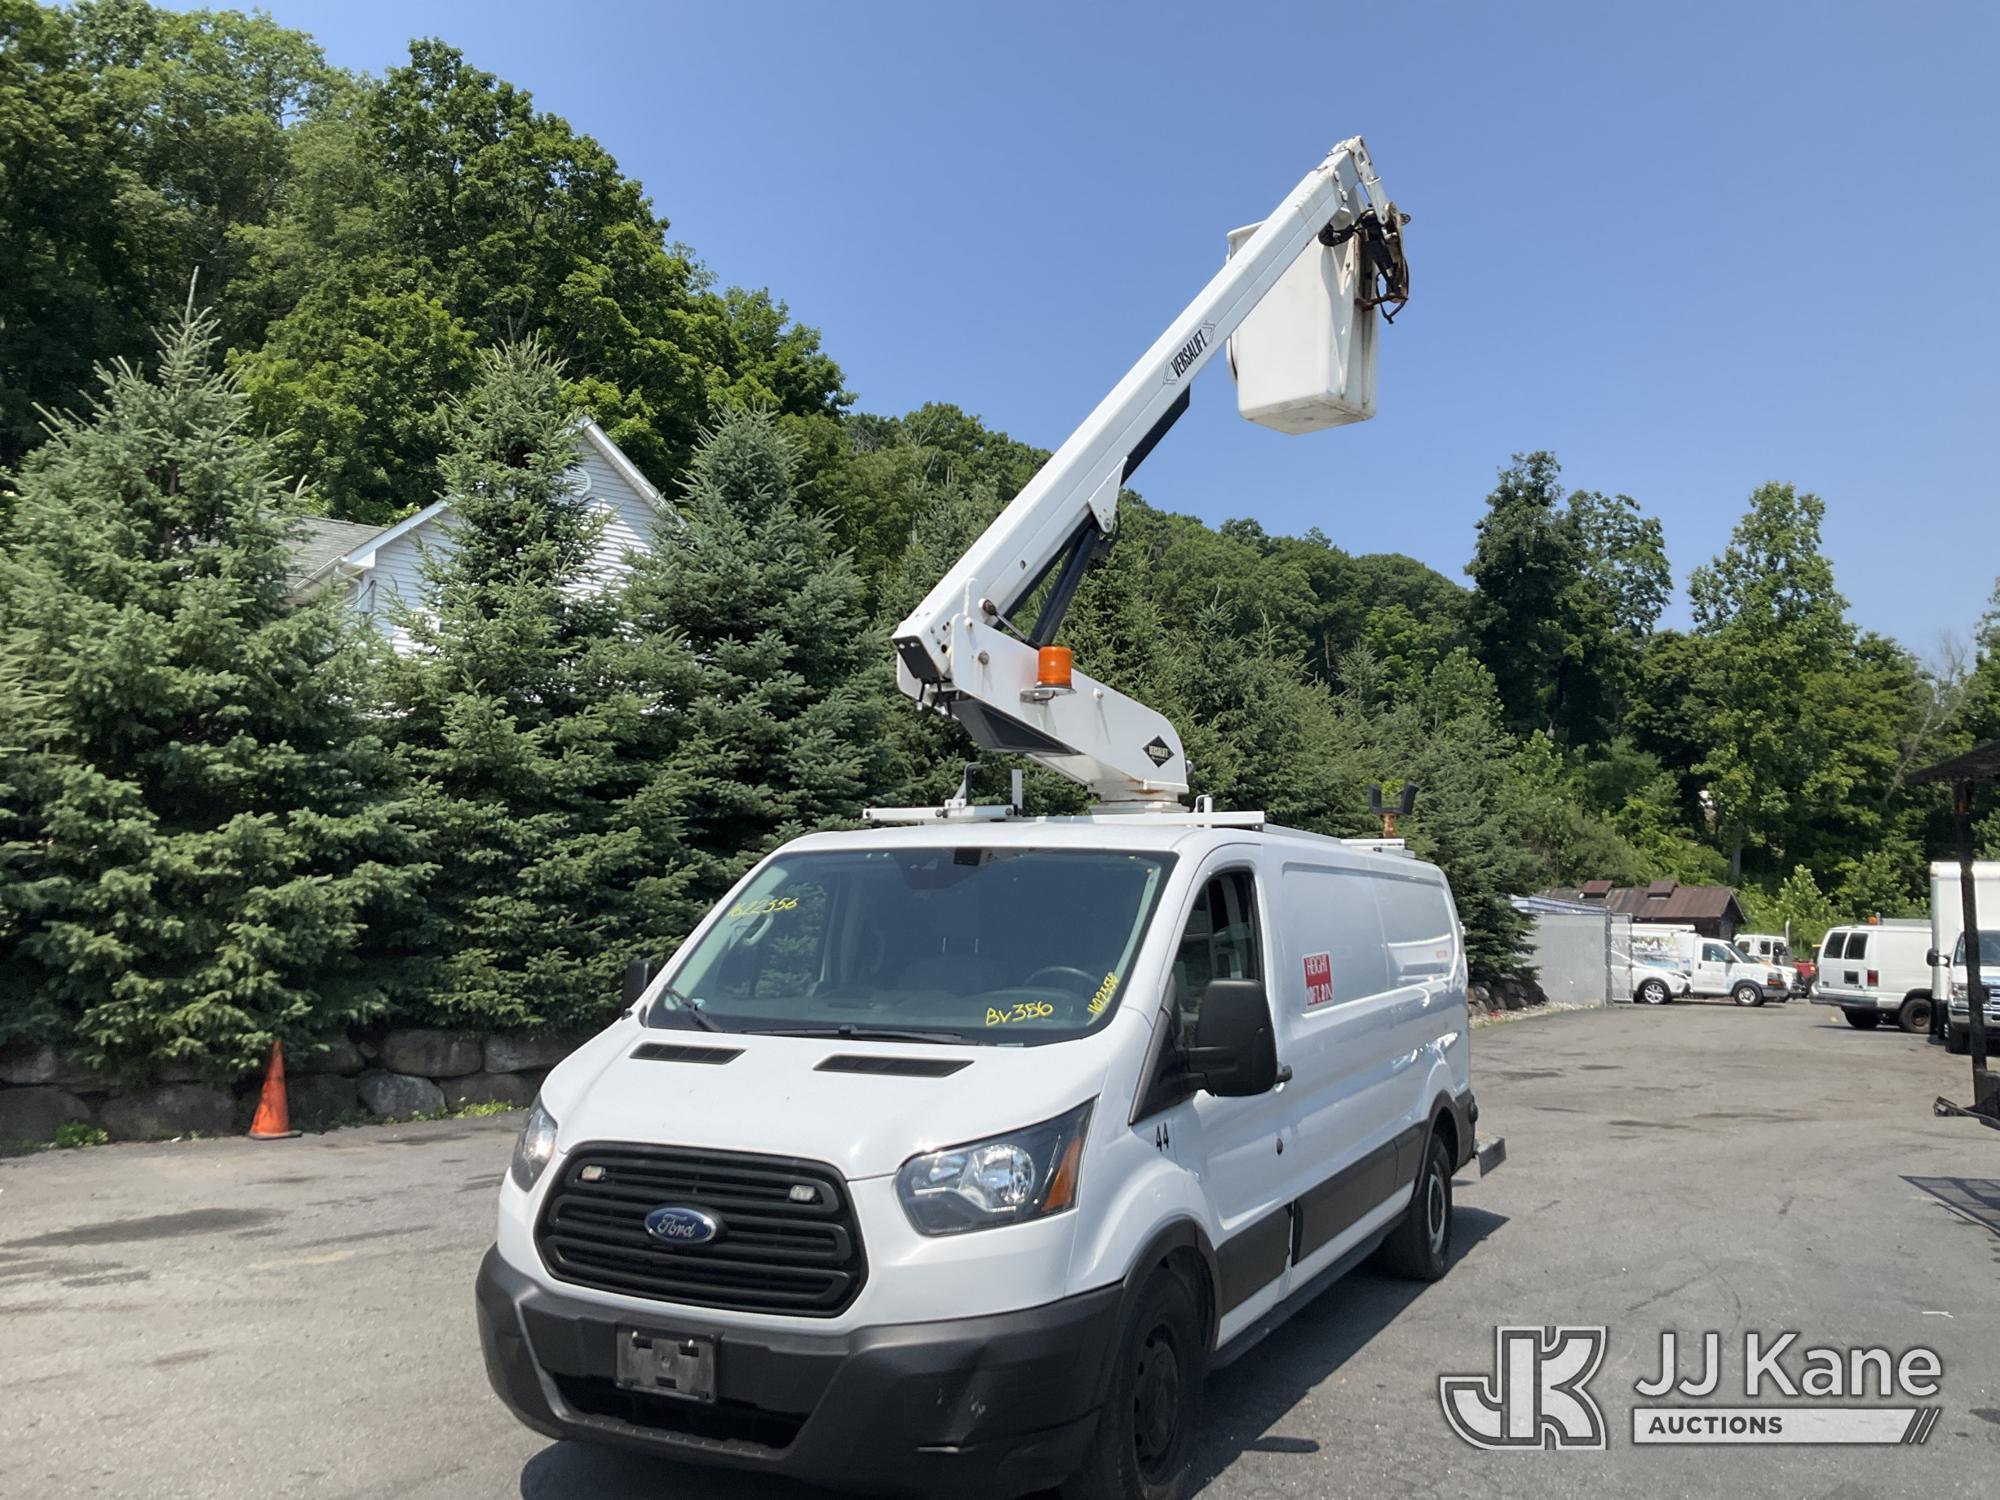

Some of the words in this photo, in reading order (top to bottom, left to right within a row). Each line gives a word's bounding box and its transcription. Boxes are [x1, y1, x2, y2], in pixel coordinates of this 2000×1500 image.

[1171, 329, 1207, 378] VERSALIFT
[1155, 1121, 1169, 1152] 44
[657, 1213, 697, 1238] Ford
